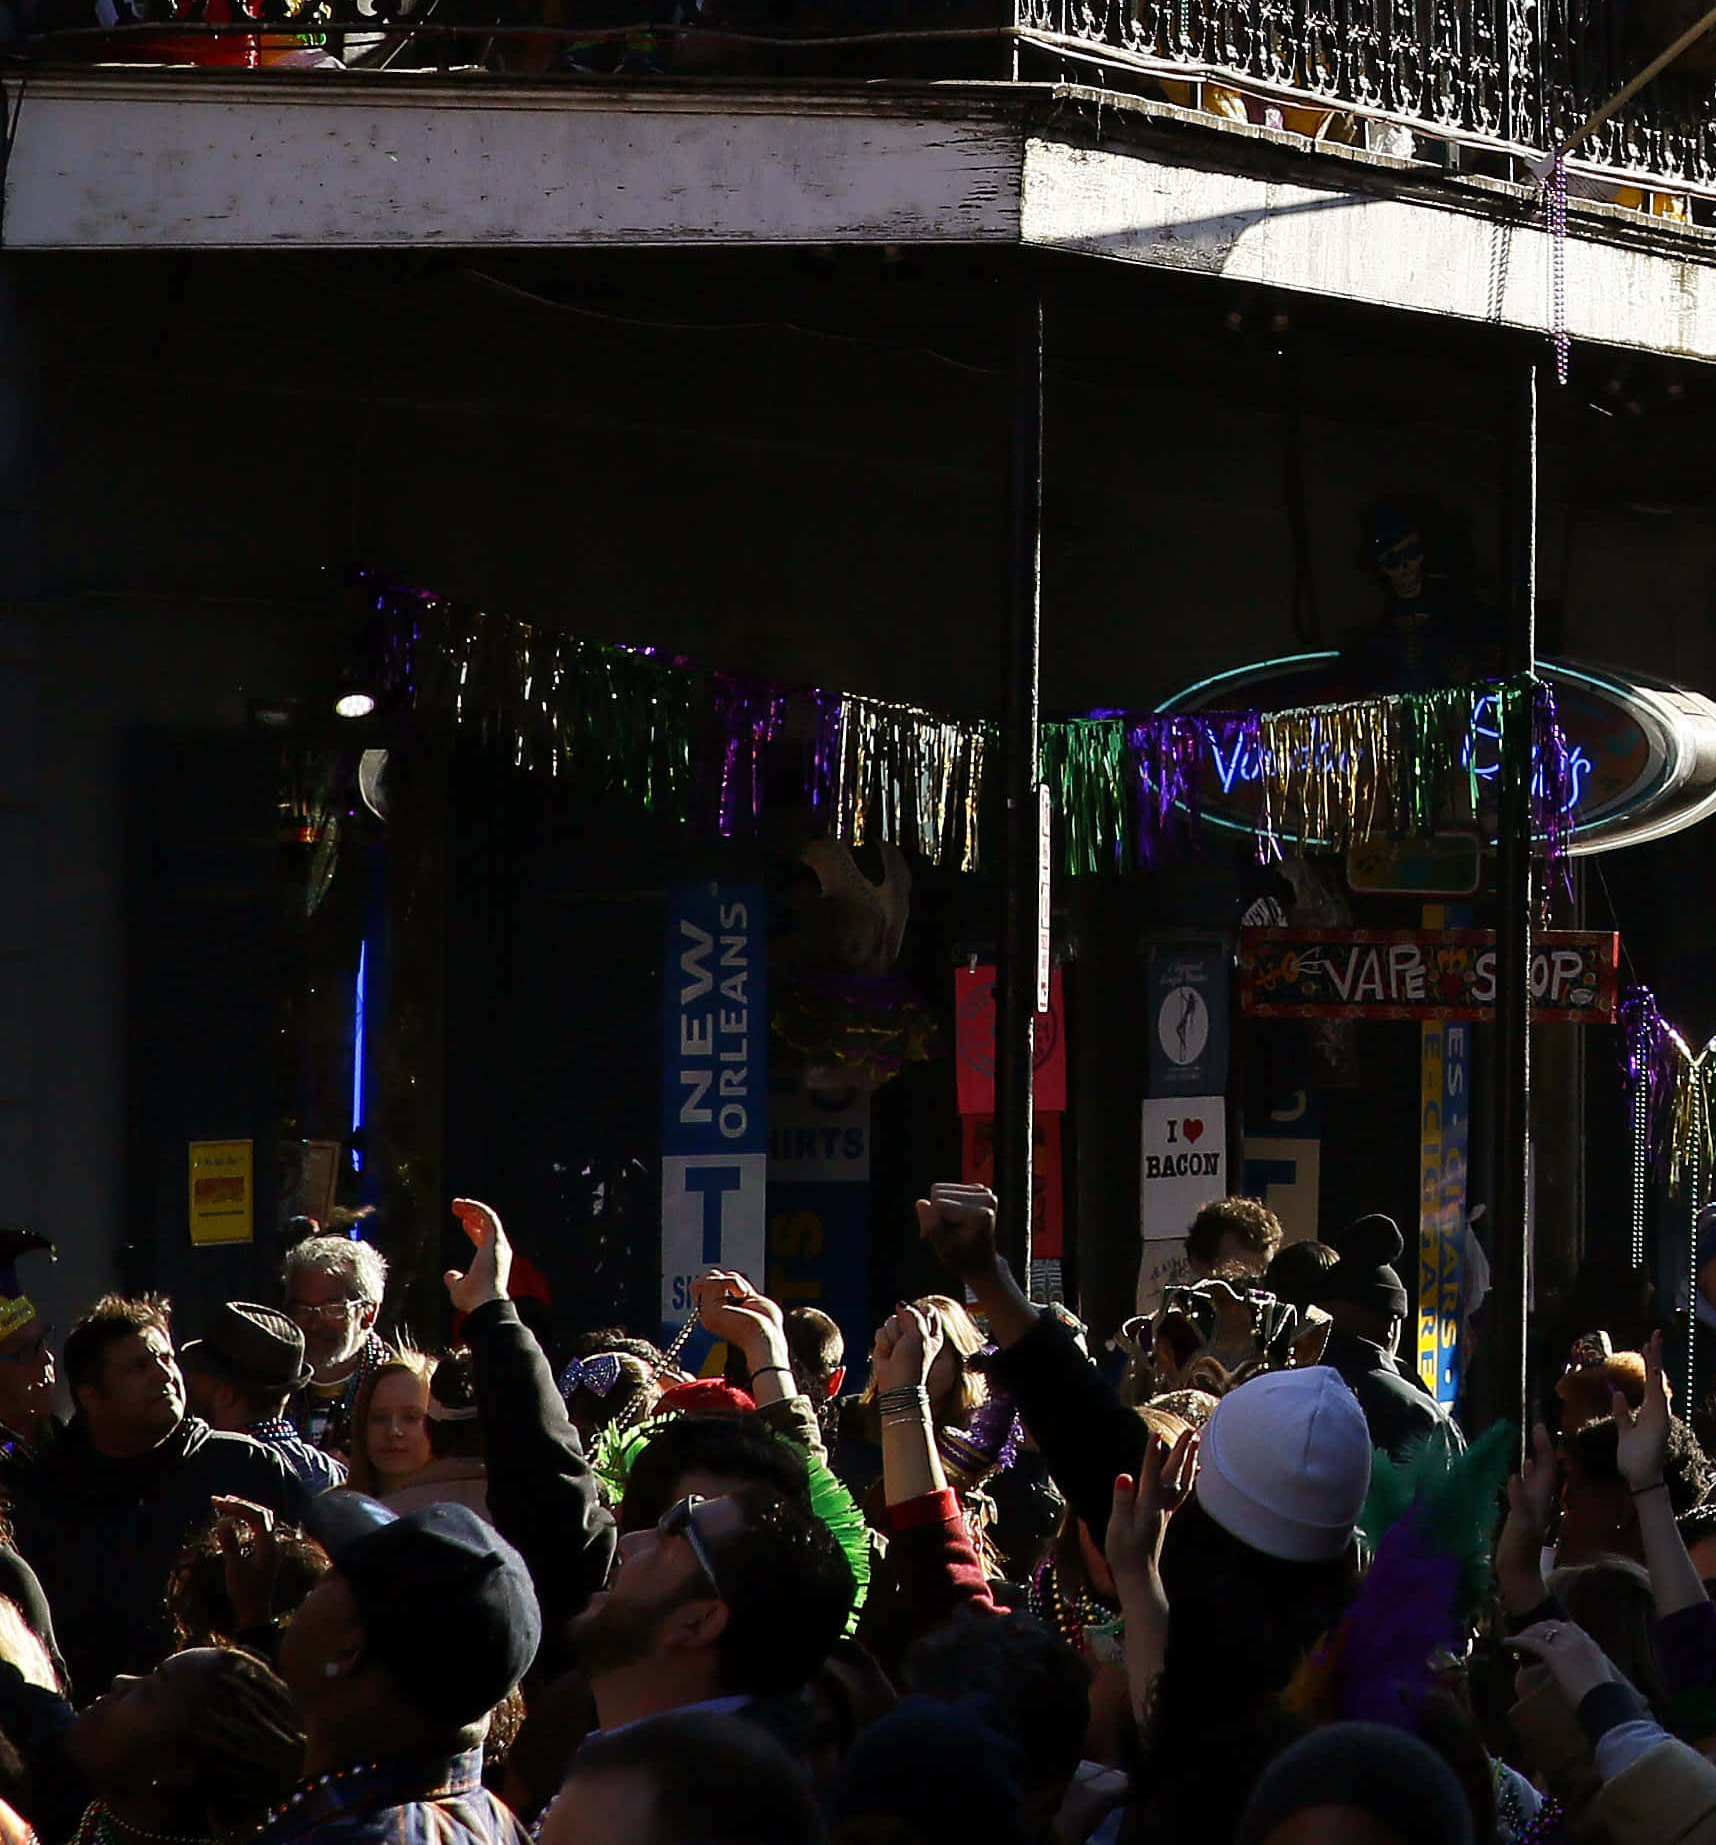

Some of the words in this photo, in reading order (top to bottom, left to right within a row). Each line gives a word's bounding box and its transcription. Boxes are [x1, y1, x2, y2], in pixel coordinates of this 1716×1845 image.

[1322, 944, 1427, 1002] VAPE
[1472, 950, 1584, 1002] SOP
[680, 919, 713, 1123] NEW
[719, 902, 749, 1139] ORLEANS
[1147, 1153, 1220, 1179] BACON
[1167, 1120, 1177, 1142] I
[685, 1166, 741, 1264] T
